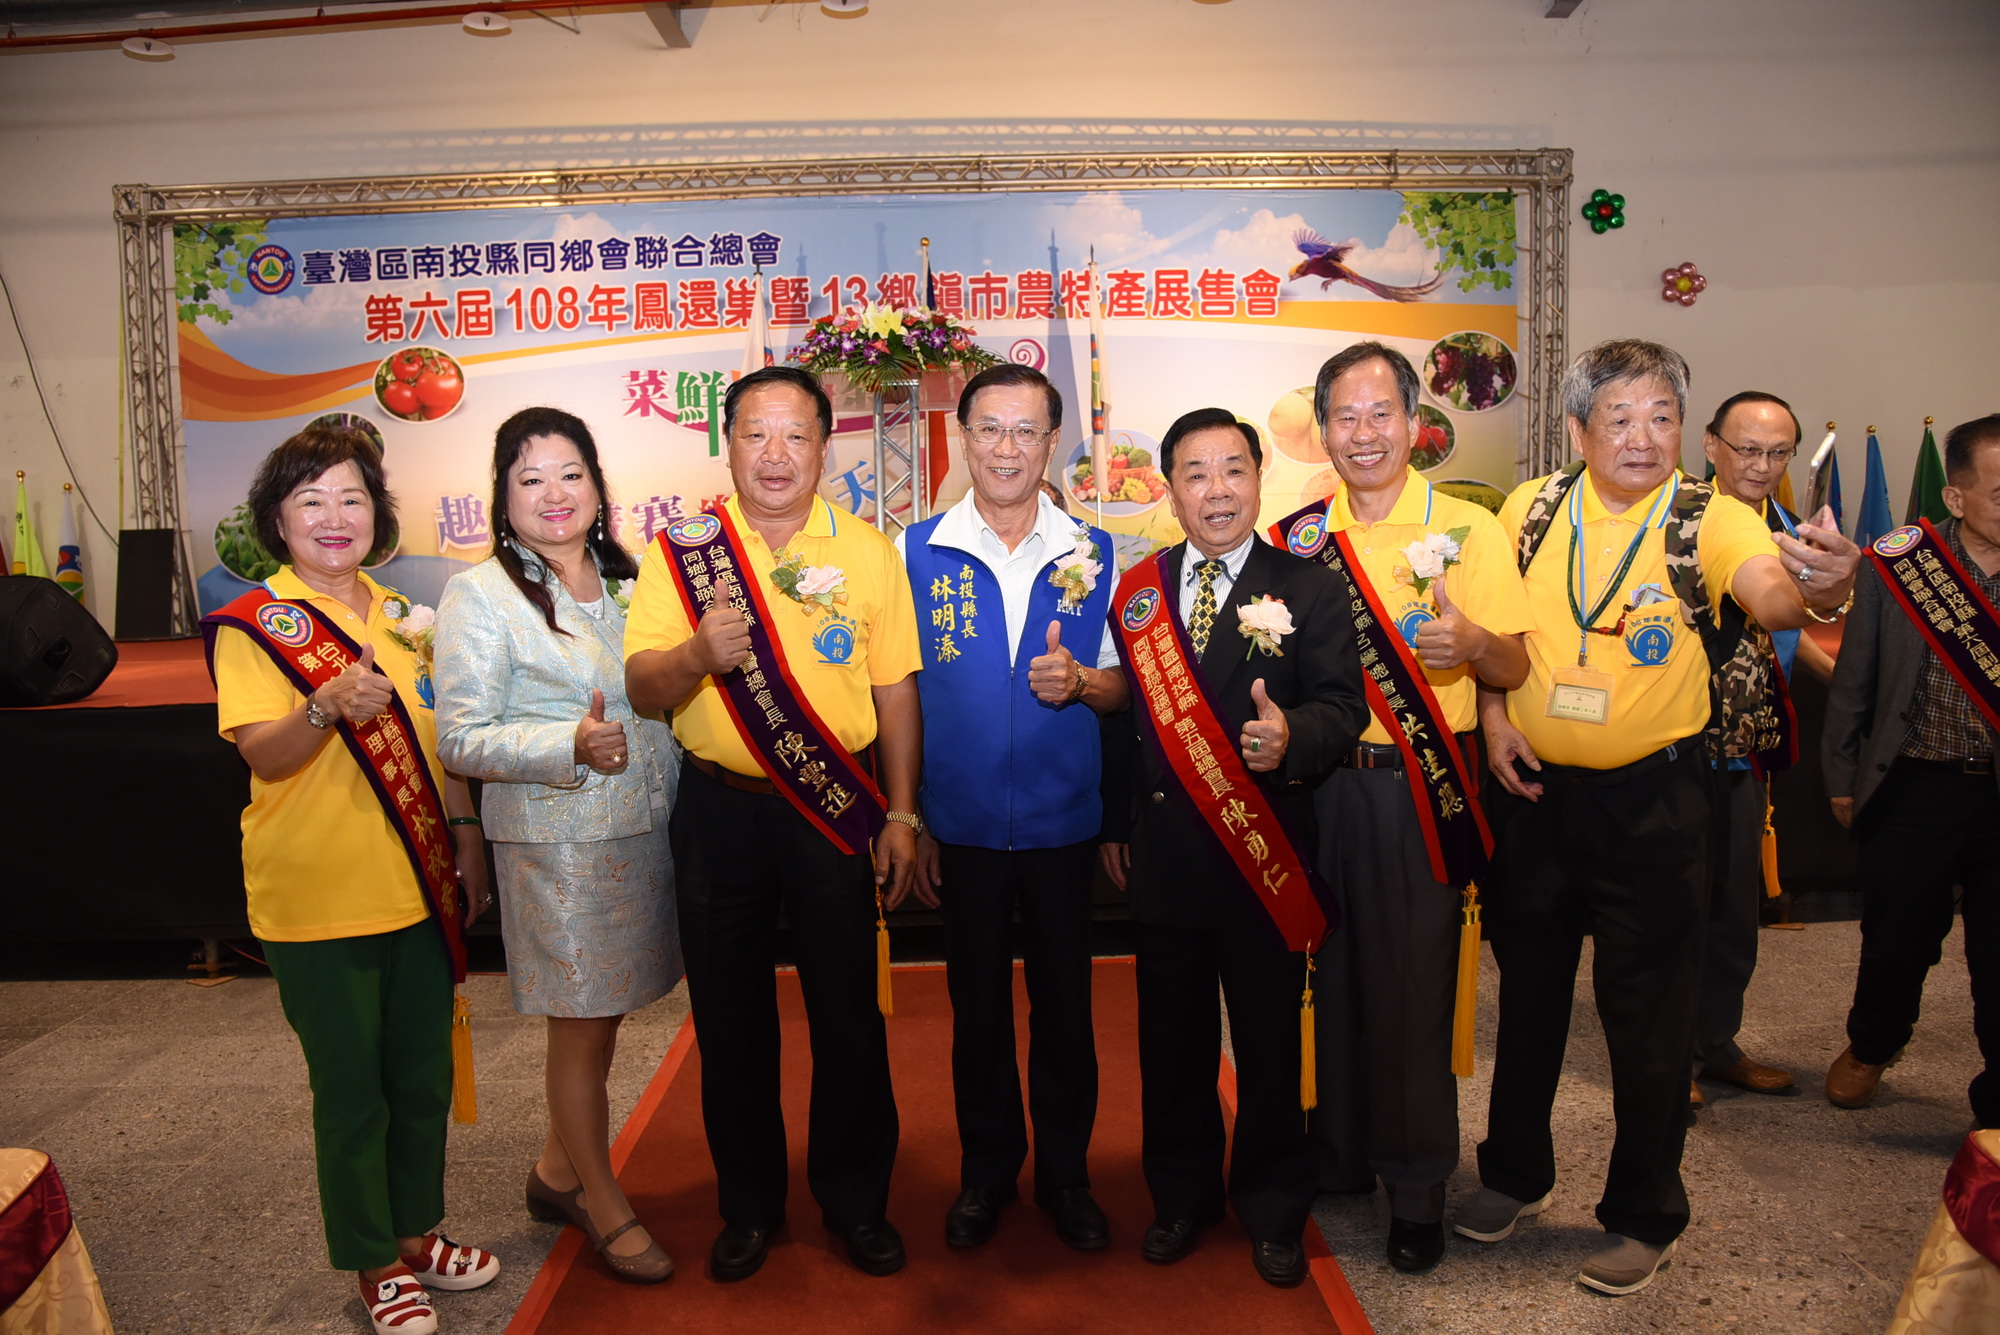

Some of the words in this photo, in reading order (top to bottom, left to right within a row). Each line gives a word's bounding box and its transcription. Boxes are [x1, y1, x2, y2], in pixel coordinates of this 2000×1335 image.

[302, 231, 781, 285] 臺灣區南投縣同鄉會聯合總會
[365, 290, 494, 343] 第六屆
[959, 564, 979, 639] 南投縣長
[1645, 633, 1659, 660] 南投
[1953, 621, 2000, 688] 第六屆副總
[1220, 798, 1290, 896] 陳勇仁
